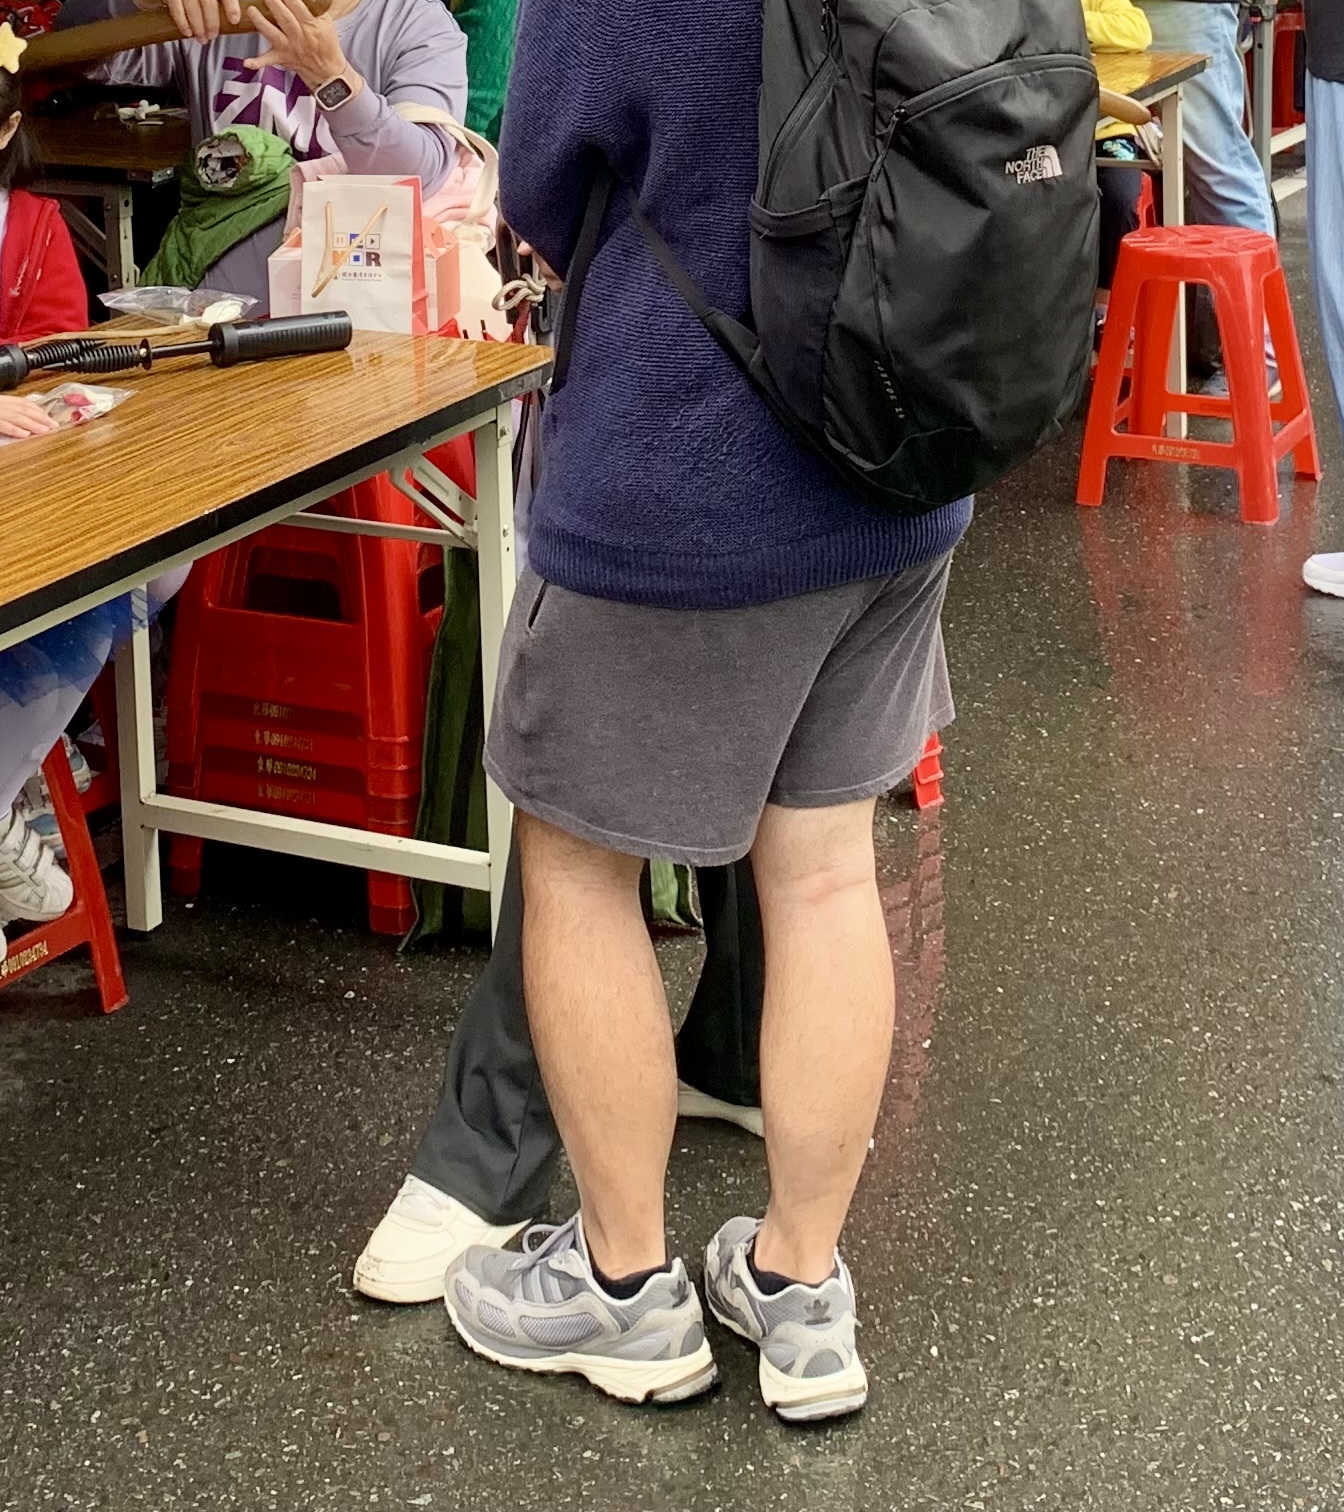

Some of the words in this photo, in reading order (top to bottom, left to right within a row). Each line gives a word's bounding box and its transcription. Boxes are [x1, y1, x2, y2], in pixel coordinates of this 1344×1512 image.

[1026, 144, 1046, 161] THE
[1005, 156, 1043, 175] NORTH
[1016, 168, 1044, 185] FACE
